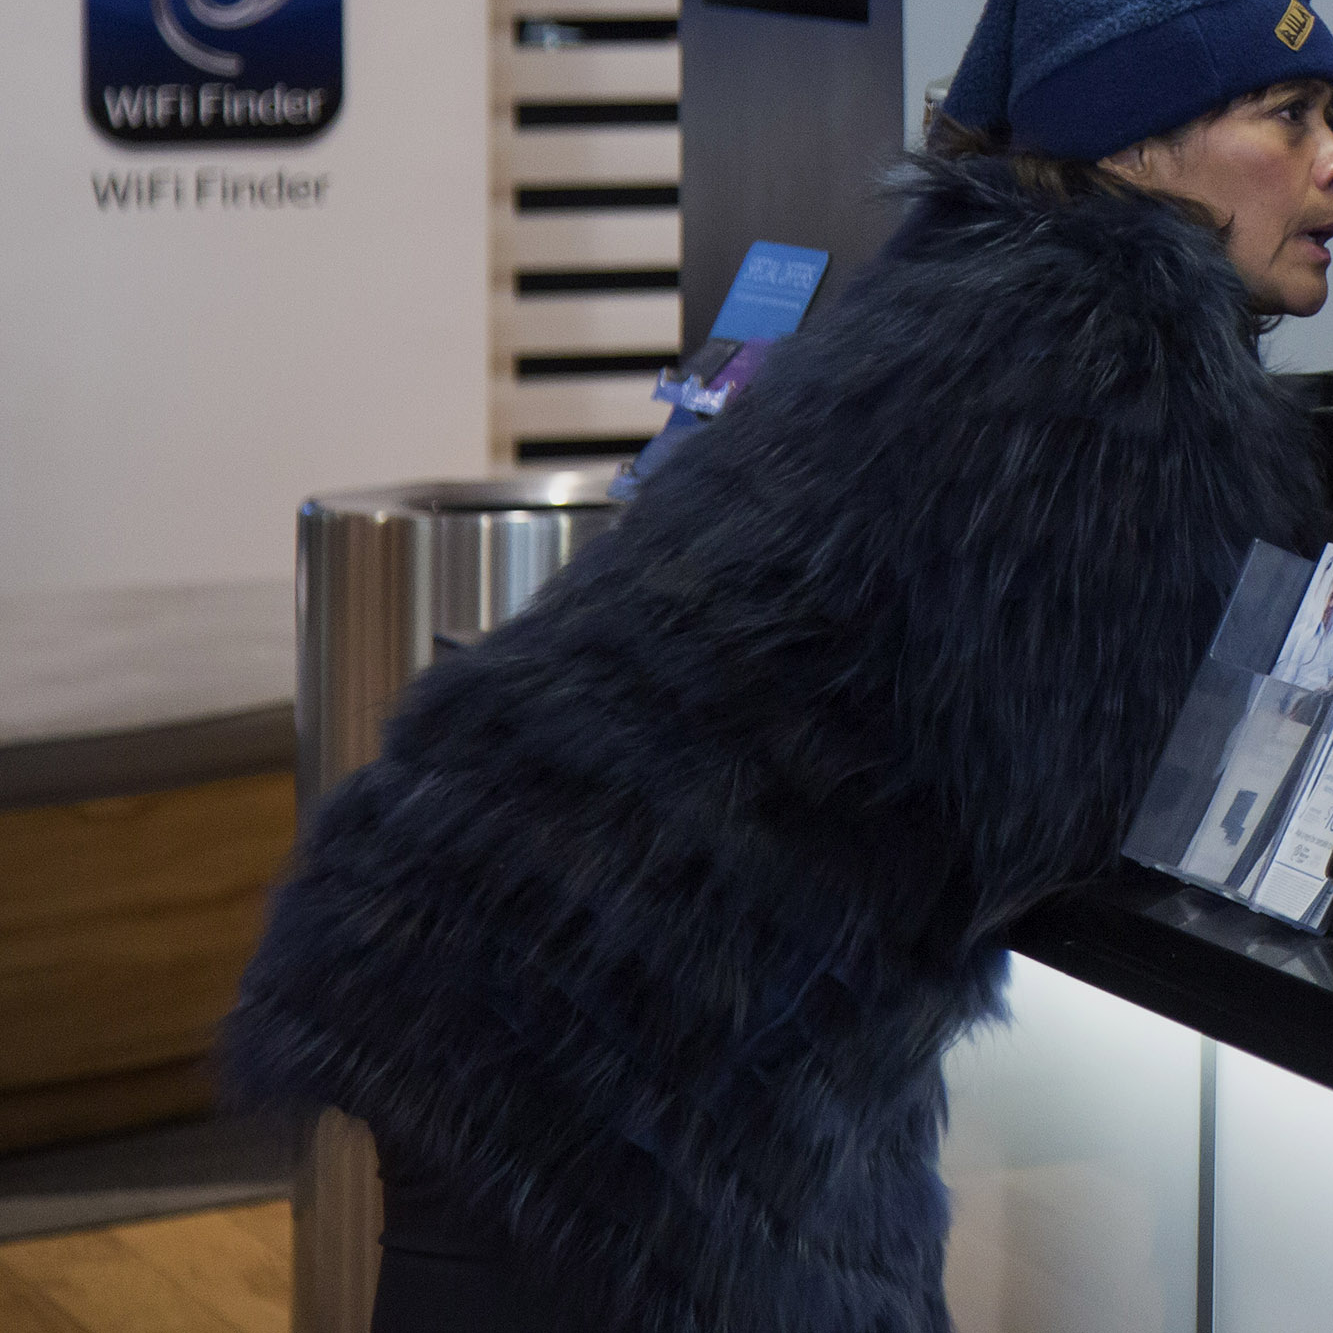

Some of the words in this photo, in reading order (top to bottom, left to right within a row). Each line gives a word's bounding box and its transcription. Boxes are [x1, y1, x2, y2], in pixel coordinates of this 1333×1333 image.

[102, 82, 195, 129] WiFi
[198, 80, 326, 128] Finder
[90, 168, 181, 213] WiFi
[194, 166, 330, 211] Finder
